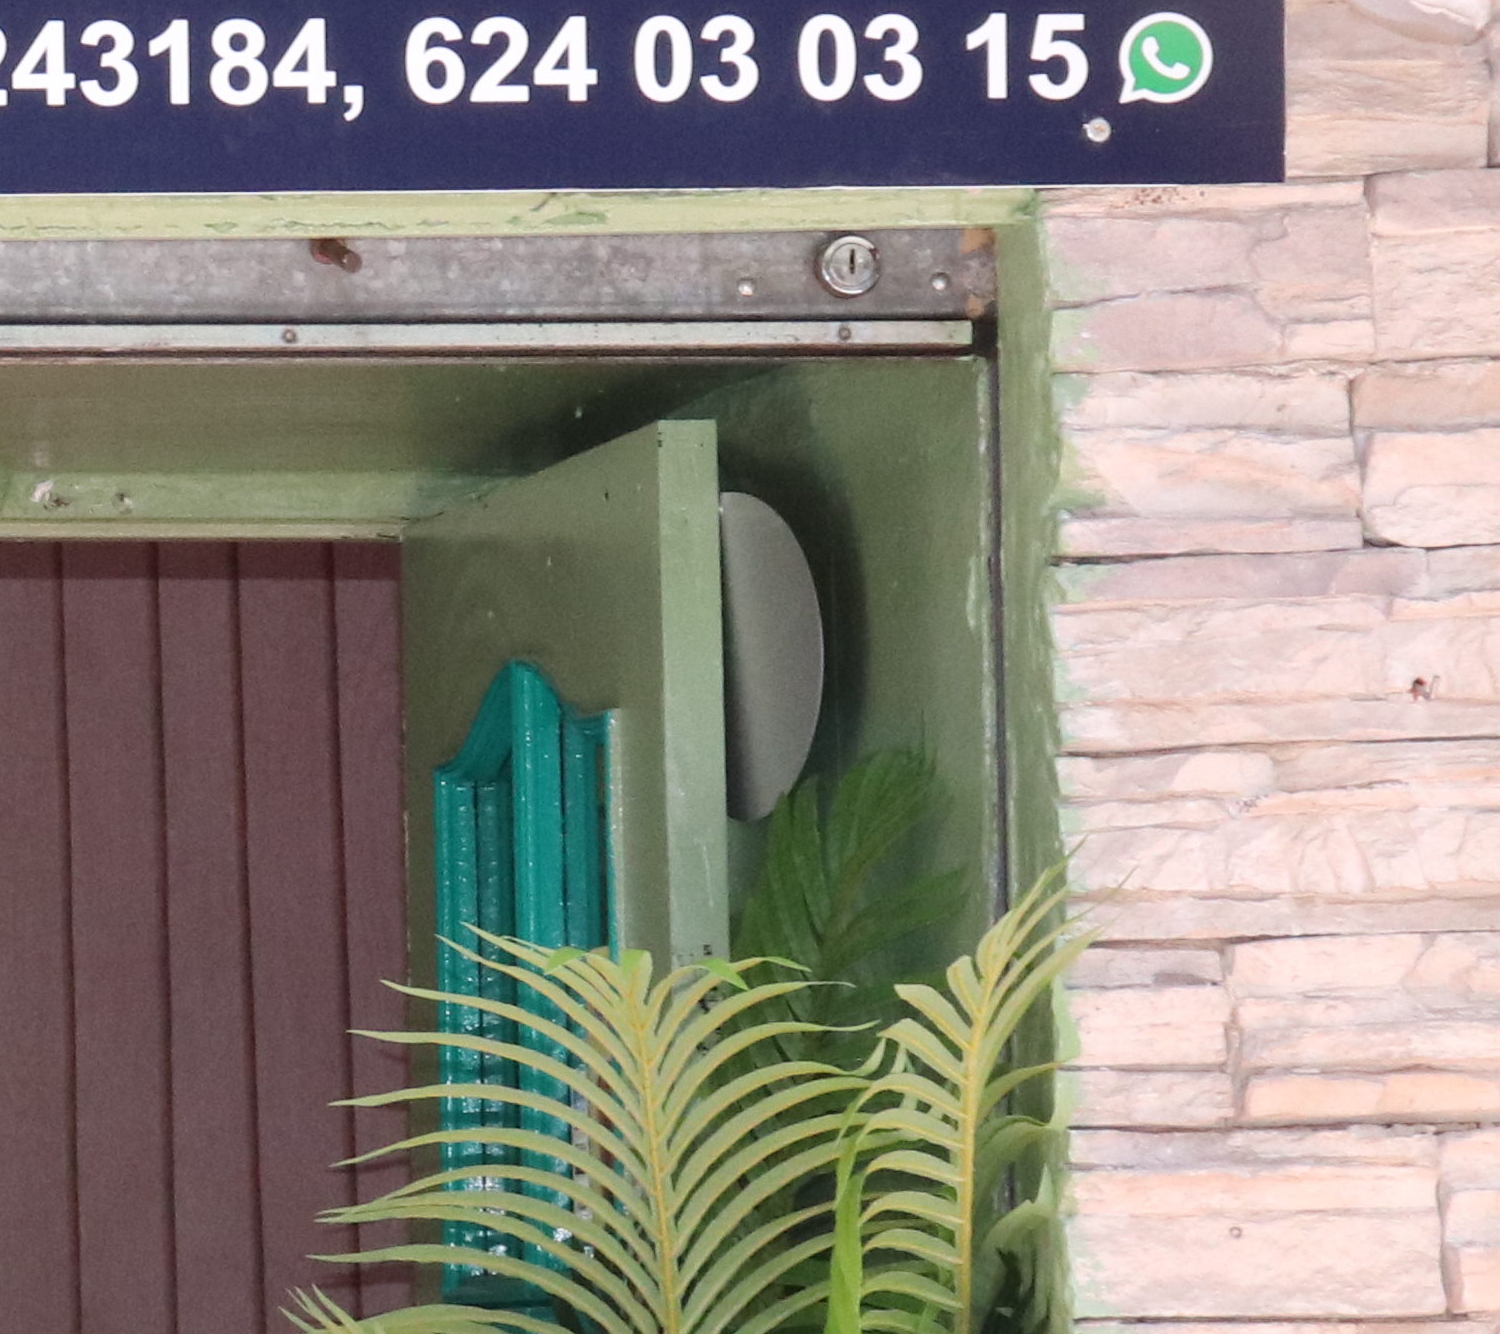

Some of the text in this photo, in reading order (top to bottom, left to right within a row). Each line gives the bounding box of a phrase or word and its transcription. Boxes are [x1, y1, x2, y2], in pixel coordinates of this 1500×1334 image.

[405, 16, 598, 104] 624
[634, 15, 759, 103] 03
[798, 13, 923, 102] 03
[966, 13, 1089, 101] 15
